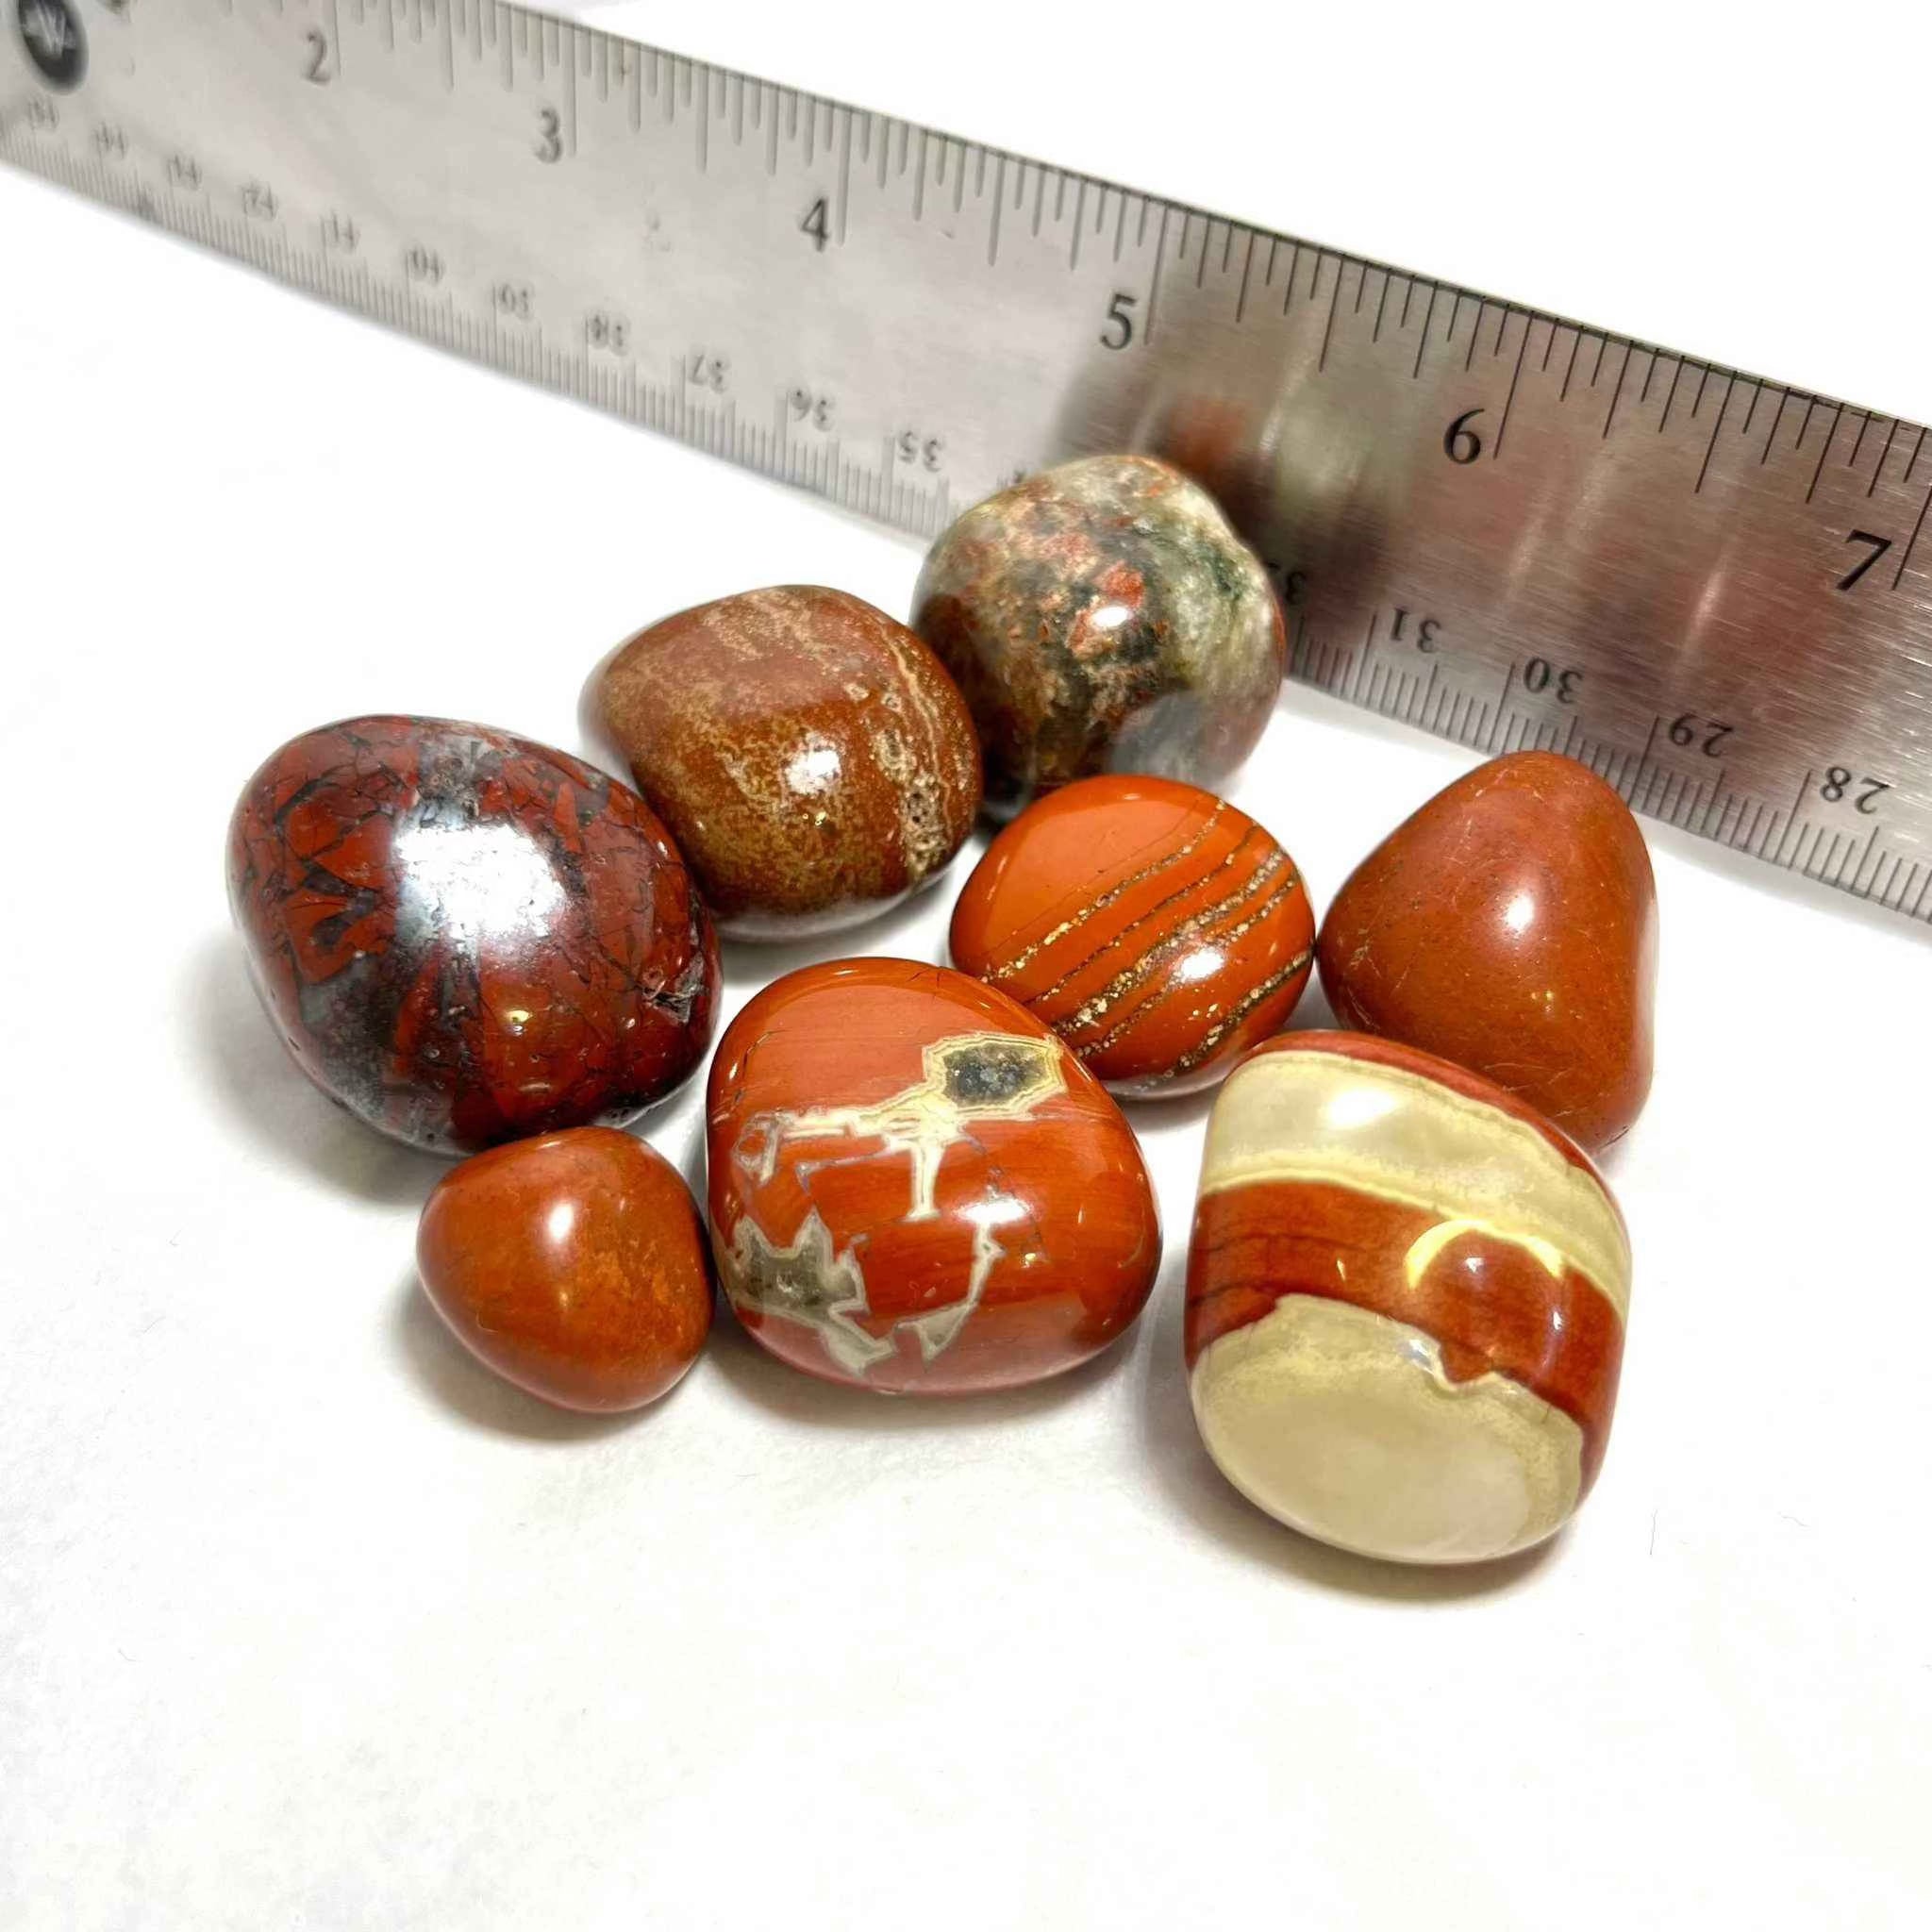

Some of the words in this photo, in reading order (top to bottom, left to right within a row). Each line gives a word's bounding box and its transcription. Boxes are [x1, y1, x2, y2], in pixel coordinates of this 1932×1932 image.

[303, 26, 332, 86] 2
[533, 106, 562, 164] 3
[800, 197, 830, 252] 4
[1099, 292, 1138, 351] 5
[691, 353, 732, 393] 37
[791, 385, 835, 432] 36
[897, 429, 945, 473] 35
[1443, 408, 1486, 466] 6
[1266, 559, 1307, 606] 3
[1835, 529, 1893, 591] 7
[1391, 607, 1441, 654] 31
[1523, 657, 1584, 705] 30
[1667, 712, 1736, 759] 29
[1819, 765, 1890, 816] 28
